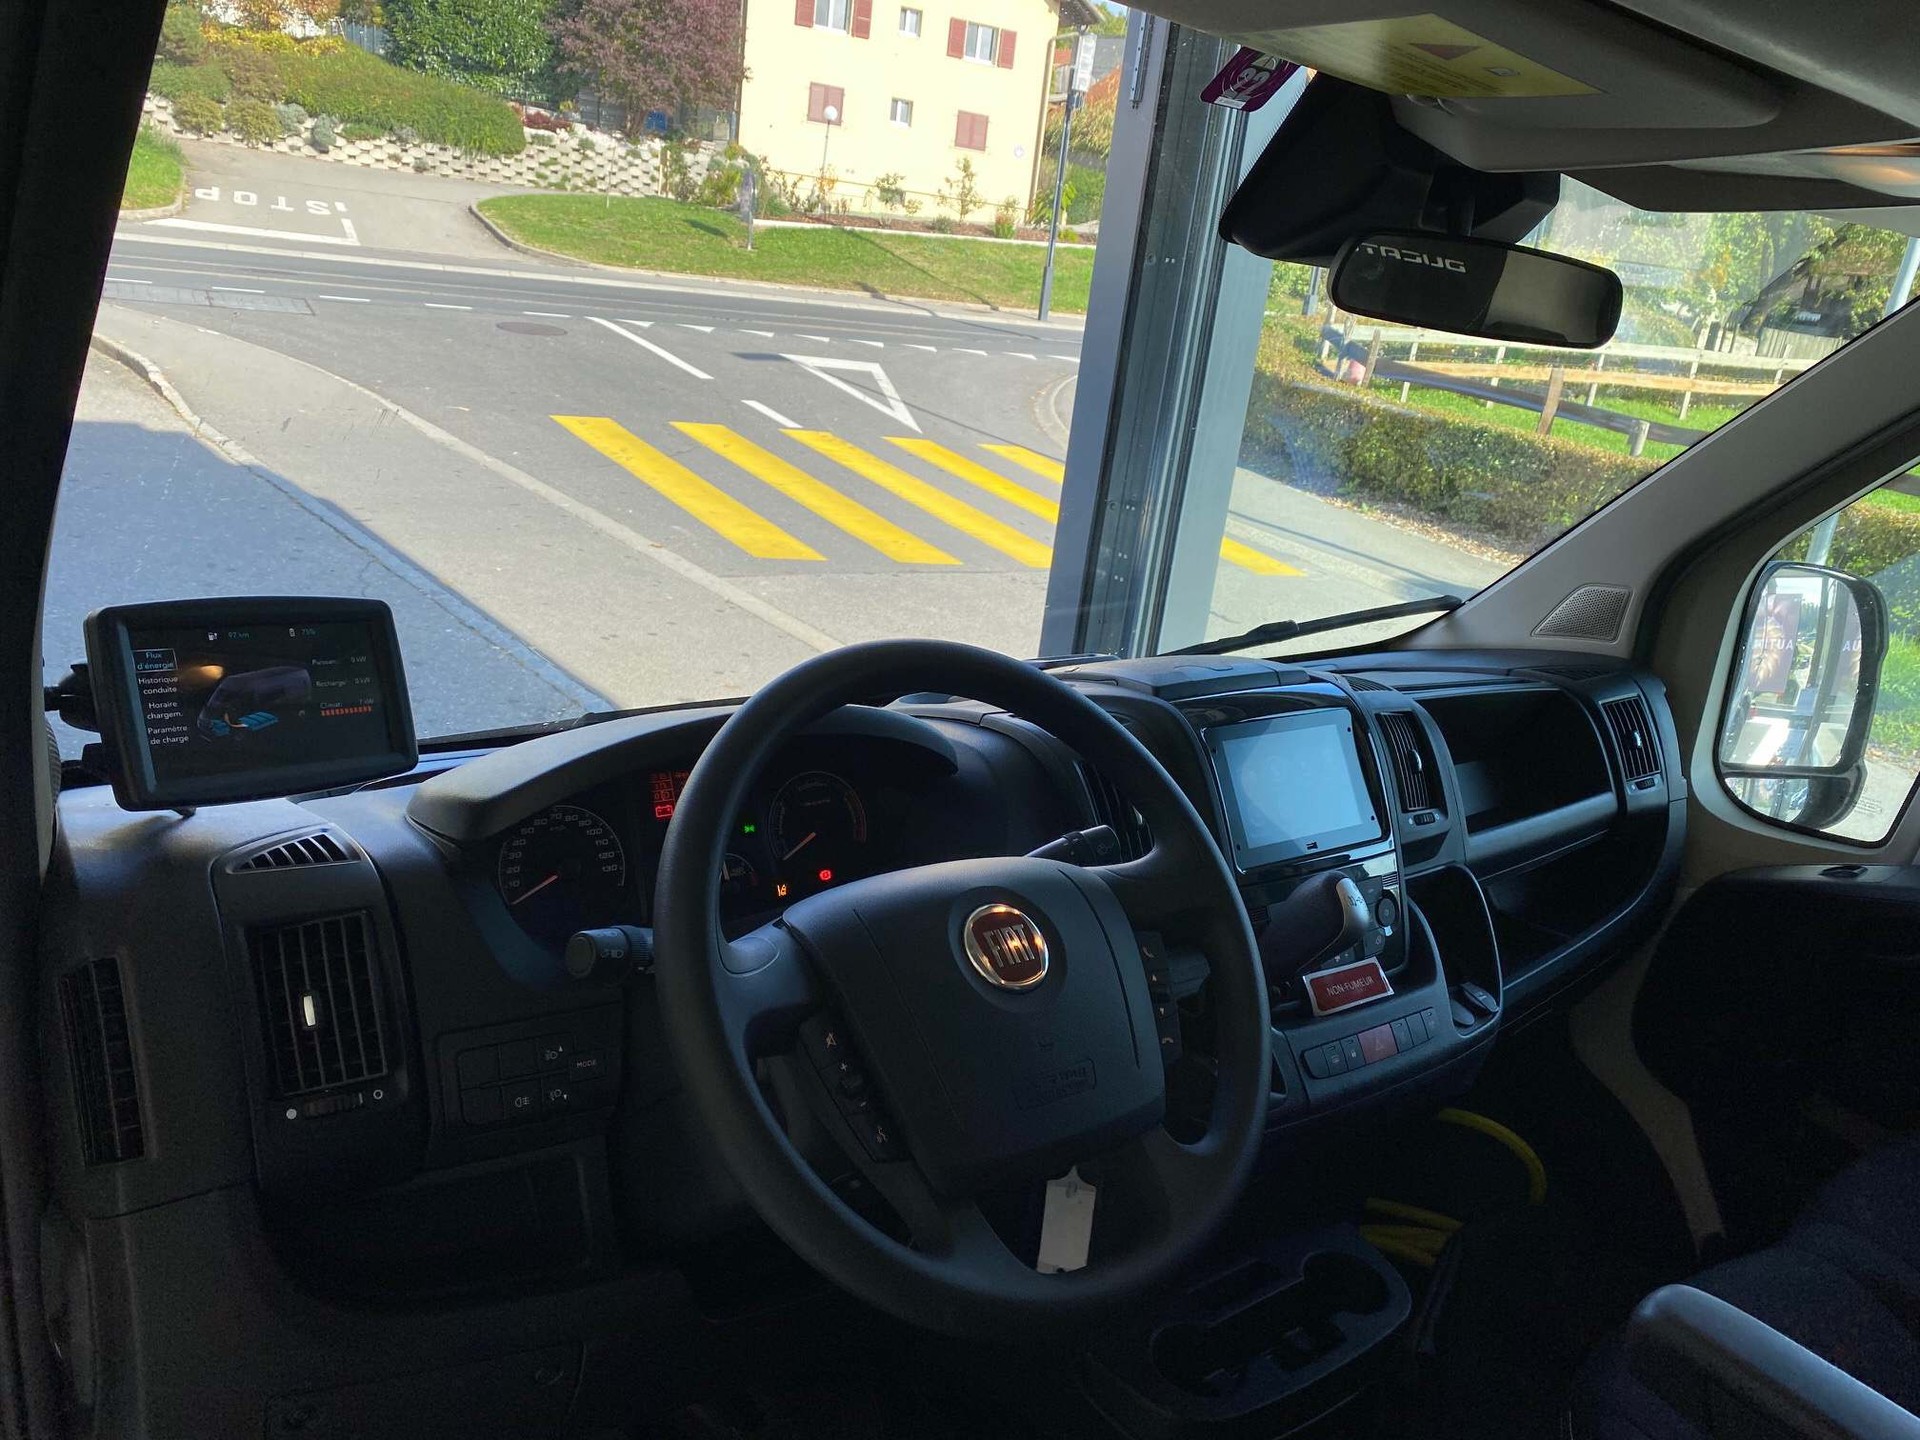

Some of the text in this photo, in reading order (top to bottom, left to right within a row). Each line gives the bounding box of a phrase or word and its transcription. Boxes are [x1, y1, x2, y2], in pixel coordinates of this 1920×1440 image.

[195, 186, 331, 215] STOP
[145, 651, 162, 660] Flux
[138, 677, 178, 686] Historique
[143, 686, 177, 695] conduite
[148, 702, 178, 710] Horaire
[150, 734, 190, 746] de charge
[982, 923, 1036, 968] FIAT
